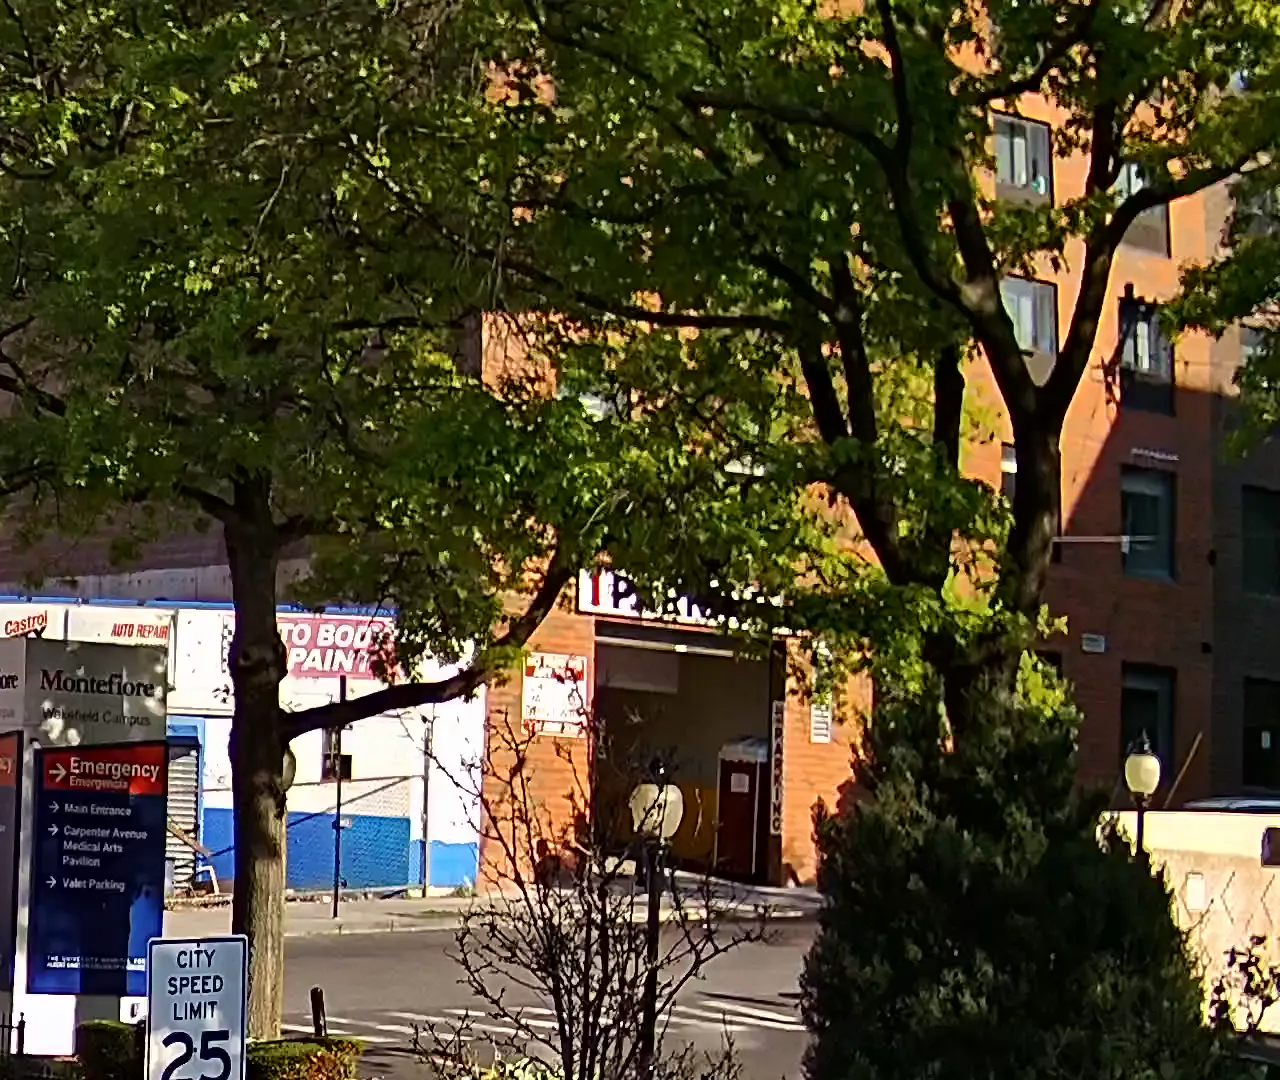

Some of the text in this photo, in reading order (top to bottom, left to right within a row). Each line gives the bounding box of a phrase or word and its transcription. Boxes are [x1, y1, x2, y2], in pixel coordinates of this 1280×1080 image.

[4, 610, 48, 636] Castrol
[111, 623, 169, 640] AUTO REPAIR
[276, 623, 311, 646] TO
[40, 669, 155, 698] Montefiore
[42, 706, 151, 727] Wakefield Campus
[69, 757, 160, 783] Emergency
[64, 803, 132, 816] Main Entrance
[64, 825, 148, 839] Carpenter Avenue
[63, 840, 123, 853] Medical Arts
[62, 855, 101, 867] Pavilion
[62, 878, 126, 893] Valet Parking
[176, 948, 216, 969] CITY
[167, 974, 224, 996] SPEED
[173, 1000, 218, 1021] LIMIT
